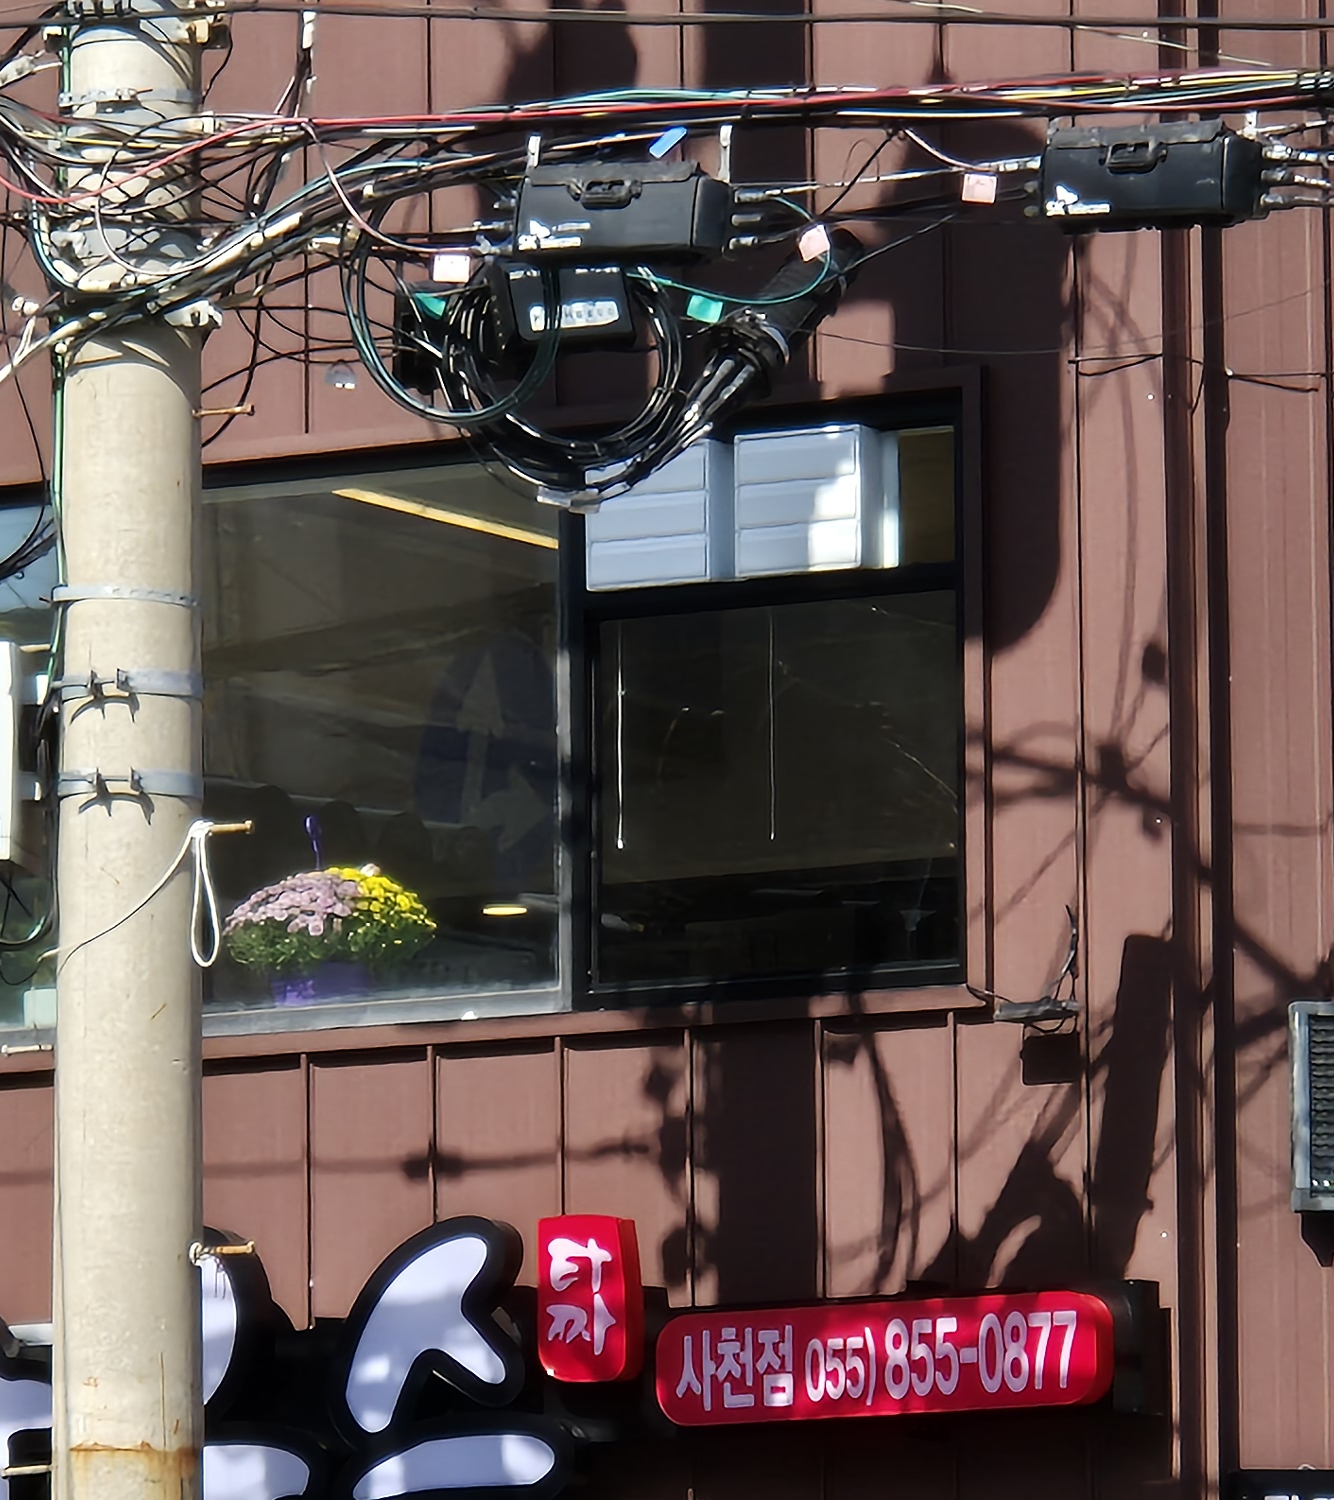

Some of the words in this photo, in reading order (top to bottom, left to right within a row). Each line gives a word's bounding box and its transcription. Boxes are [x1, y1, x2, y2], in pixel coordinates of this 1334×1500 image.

[547, 1237, 617, 1356] 타짜
[675, 1325, 795, 1411] 사천점
[804, 1326, 877, 1405] 055)
[883, 1309, 1078, 1401] 855-0877
